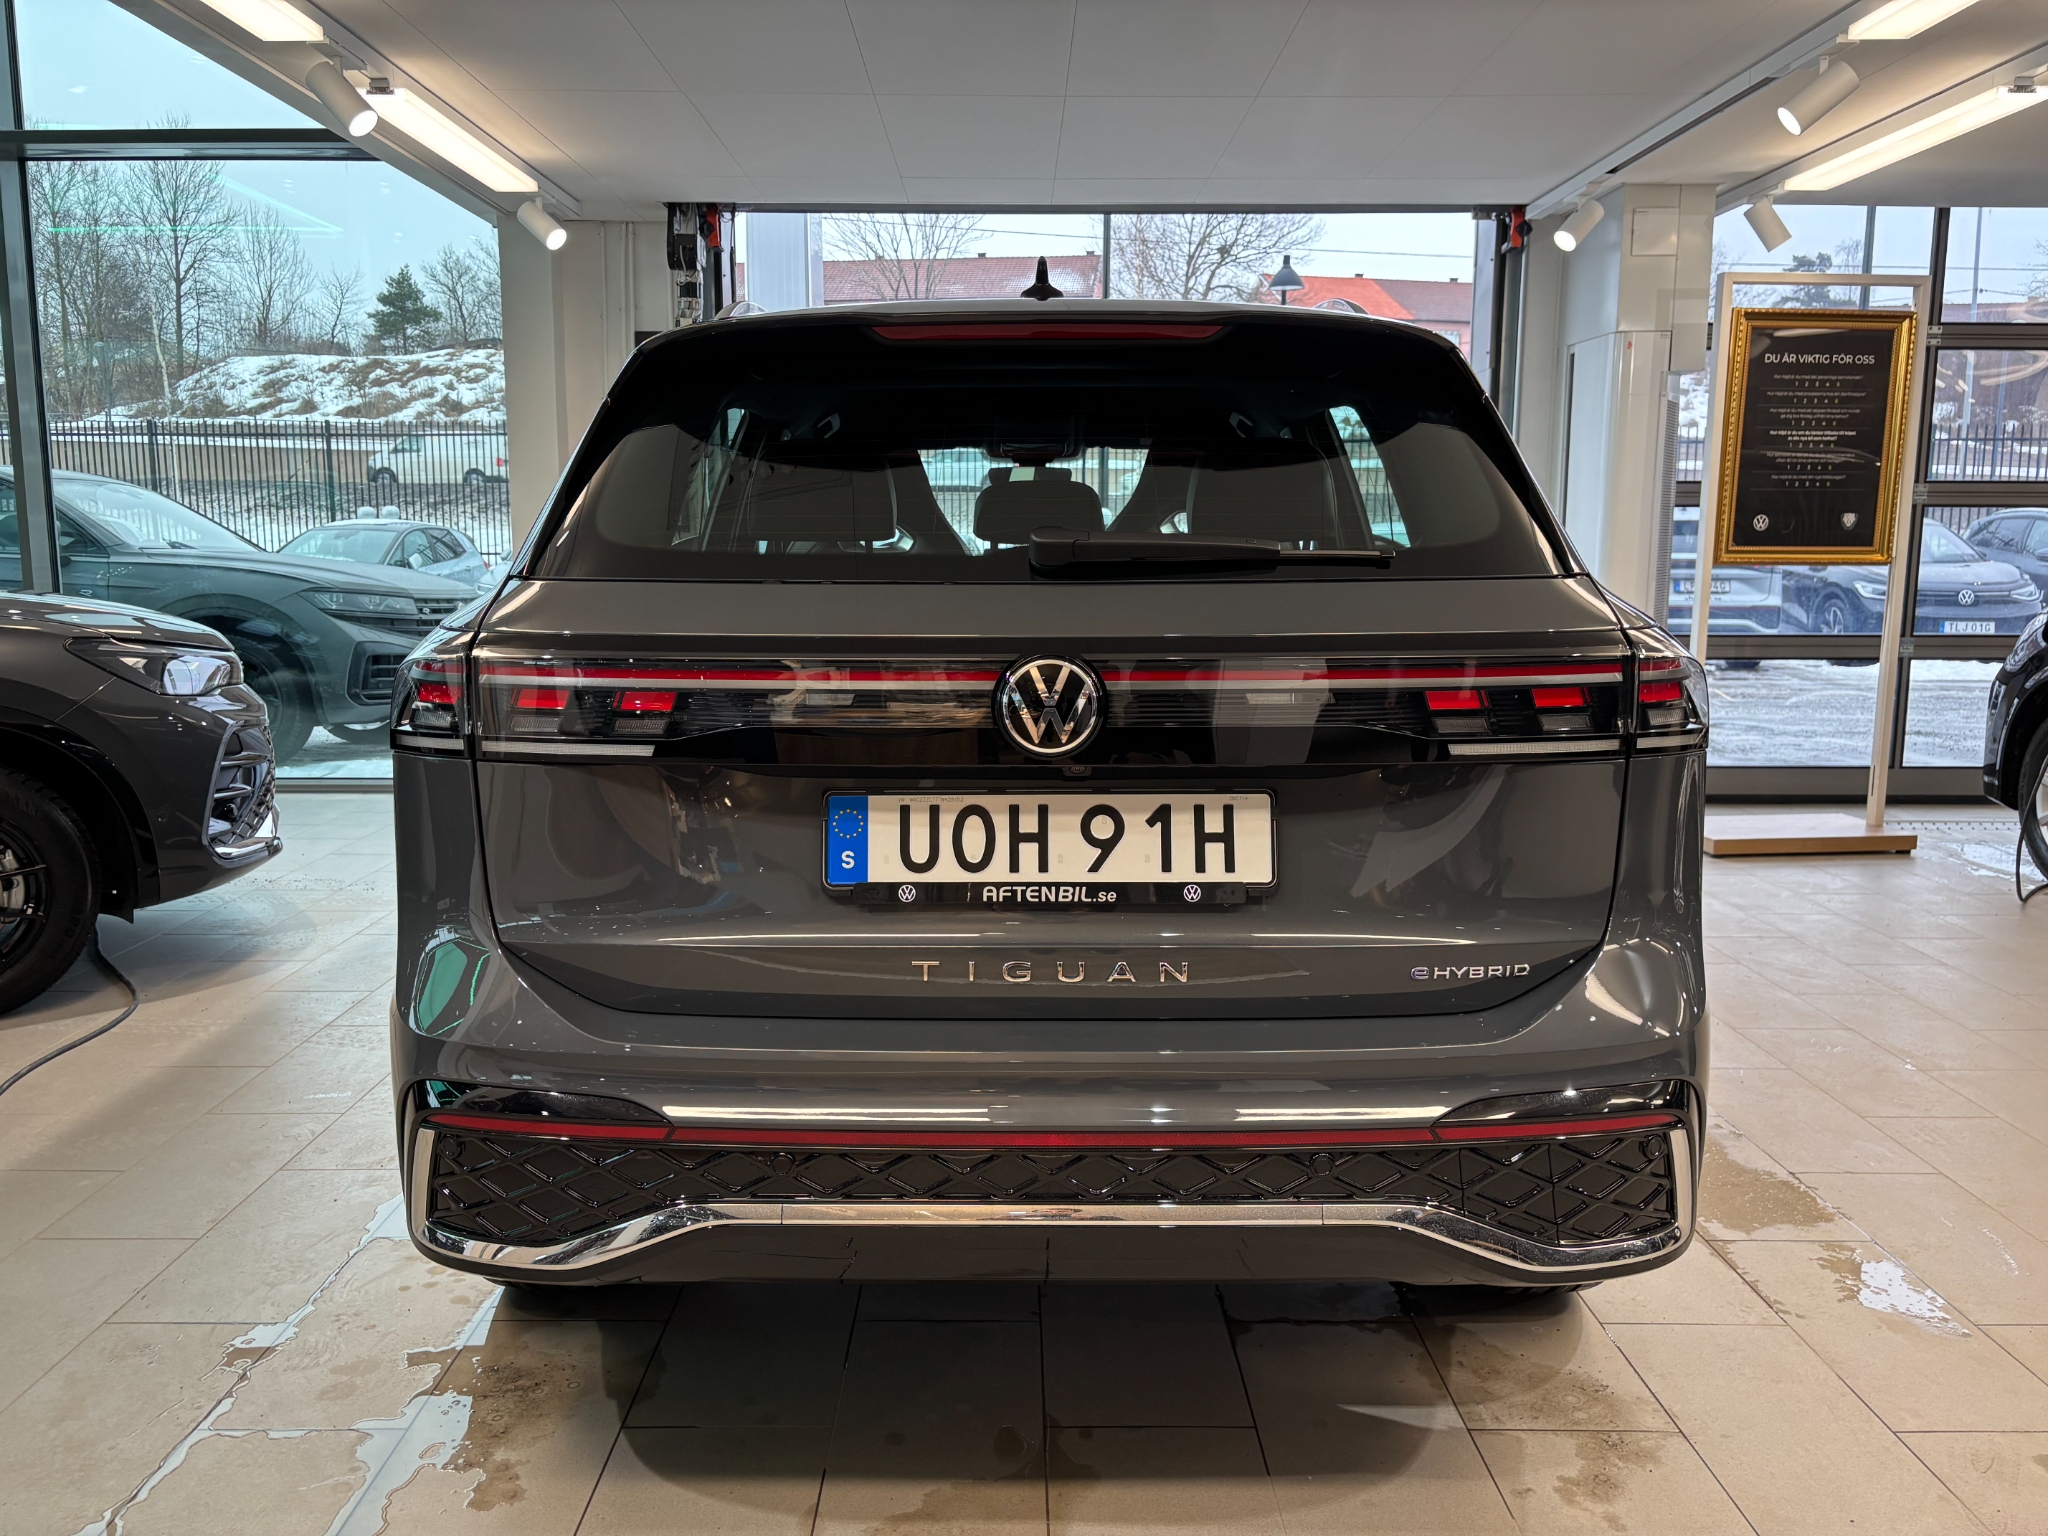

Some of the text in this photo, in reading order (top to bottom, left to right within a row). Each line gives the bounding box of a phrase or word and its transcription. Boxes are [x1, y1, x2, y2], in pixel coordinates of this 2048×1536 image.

[1764, 352, 1876, 365] DU ÄR VIKTIG FÖR OSS
[1948, 622, 1991, 633] TLJ 01G
[900, 804, 1236, 874] UOH 91H
[840, 850, 855, 869] S
[982, 886, 1117, 902] AFTENBIL.se
[911, 960, 1189, 983] TIGUAN
[1410, 964, 1530, 980] eHYBRID
